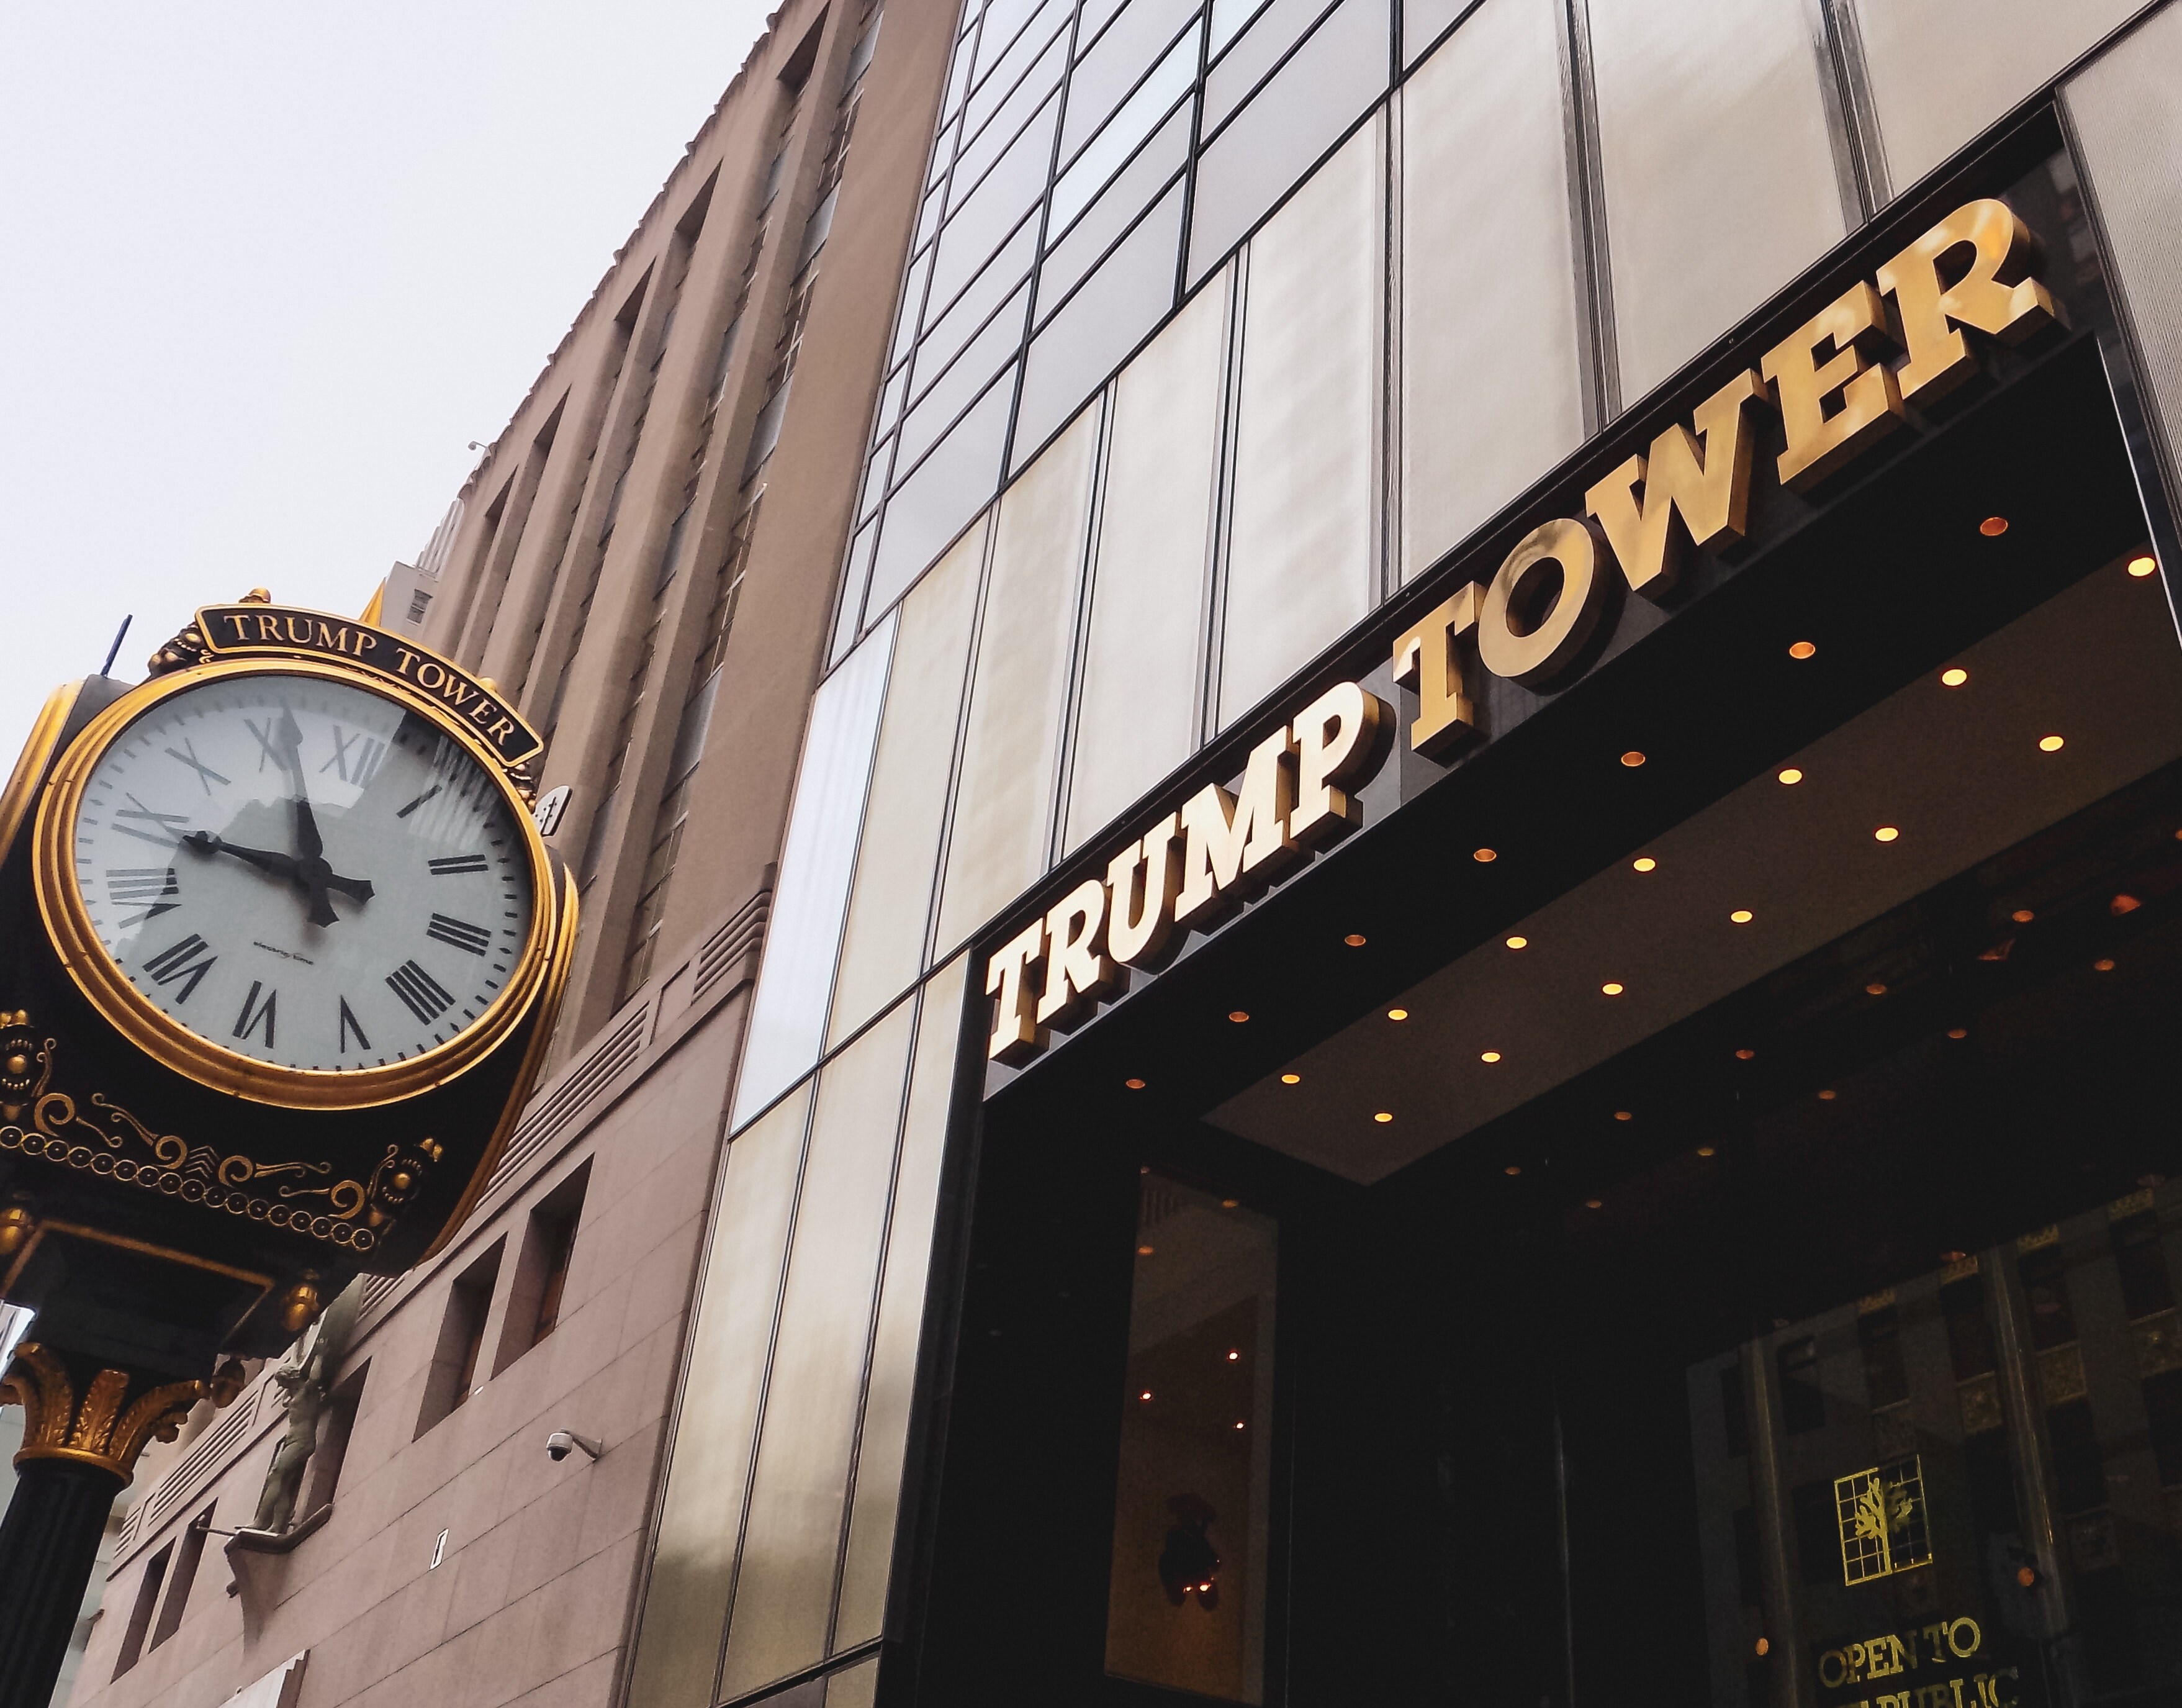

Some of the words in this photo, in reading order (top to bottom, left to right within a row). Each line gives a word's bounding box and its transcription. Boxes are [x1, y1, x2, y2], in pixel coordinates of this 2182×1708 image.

[985, 682, 1368, 1060] TRUMP
[1392, 199, 2052, 751] TOWER
[223, 614, 377, 657] TRUMP
[396, 647, 514, 746] TOWER
[165, 737, 232, 797] X
[106, 867, 183, 929] VIII
[428, 854, 489, 876] II
[426, 912, 492, 957] III
[142, 933, 219, 1005] VII
[1819, 1629, 1918, 1688] OPEN
[1923, 1616, 1981, 1663] TO
